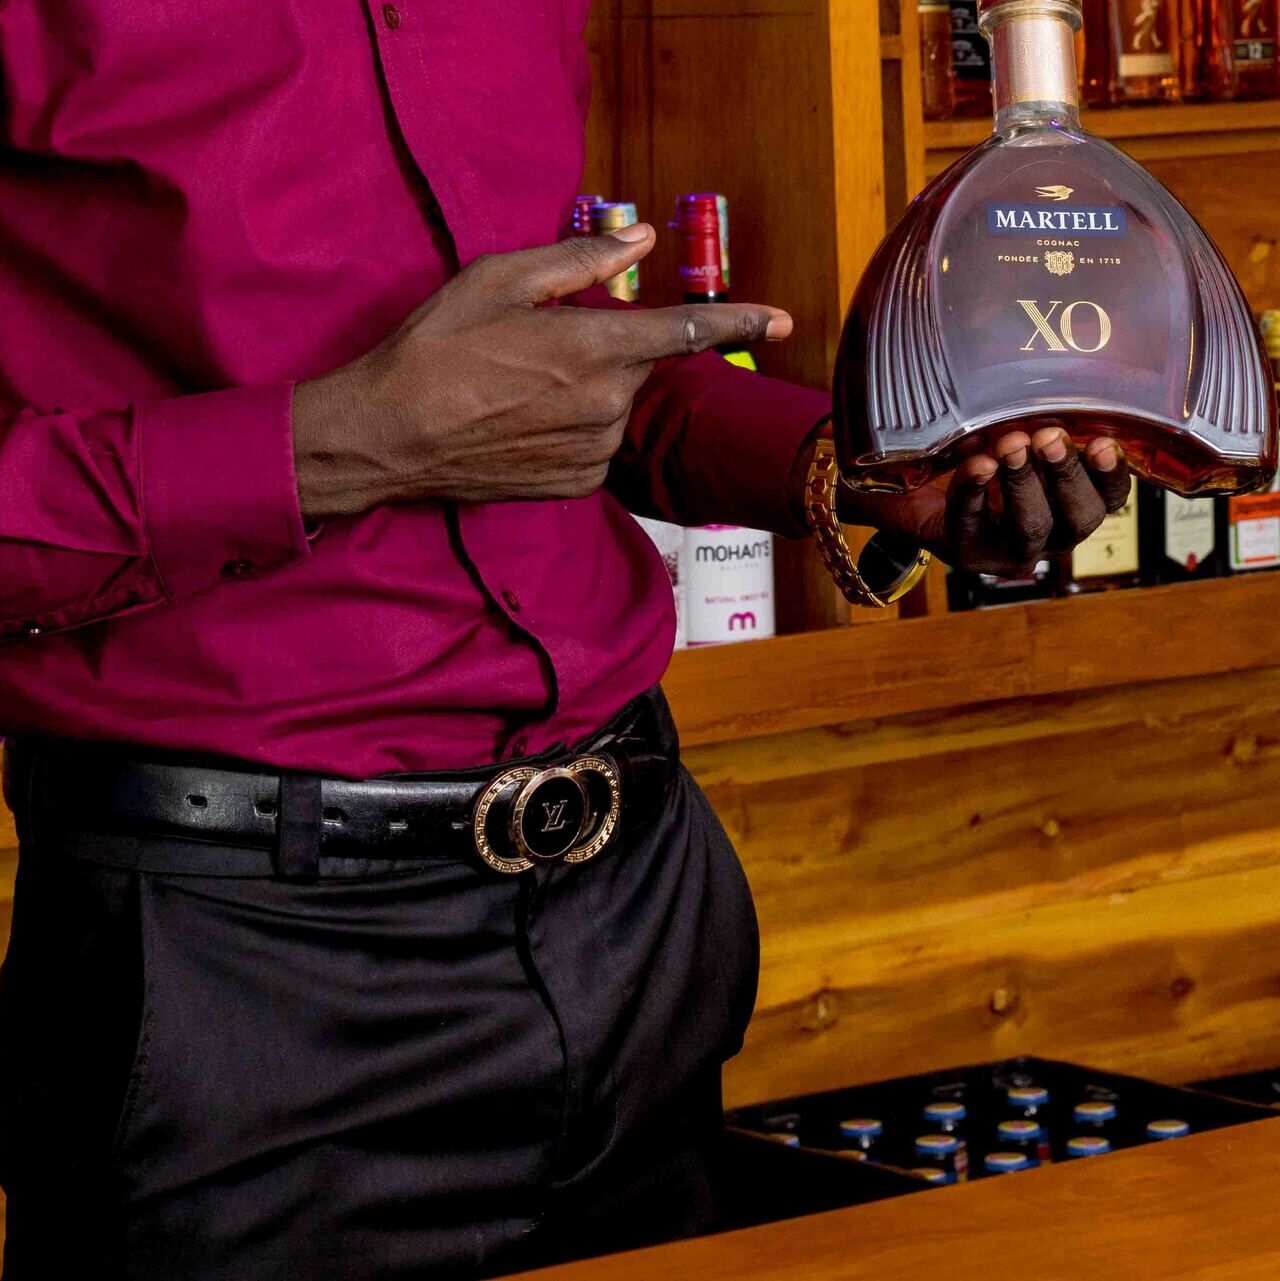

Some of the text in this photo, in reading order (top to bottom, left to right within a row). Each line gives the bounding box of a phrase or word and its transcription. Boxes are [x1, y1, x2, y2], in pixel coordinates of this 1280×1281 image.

[995, 210, 1119, 230] MARTELL
[1037, 239, 1080, 247] COGNAC
[998, 255, 1039, 263] FONDÉE
[1099, 257, 1121, 265] 1715
[1016, 299, 1112, 353] XO
